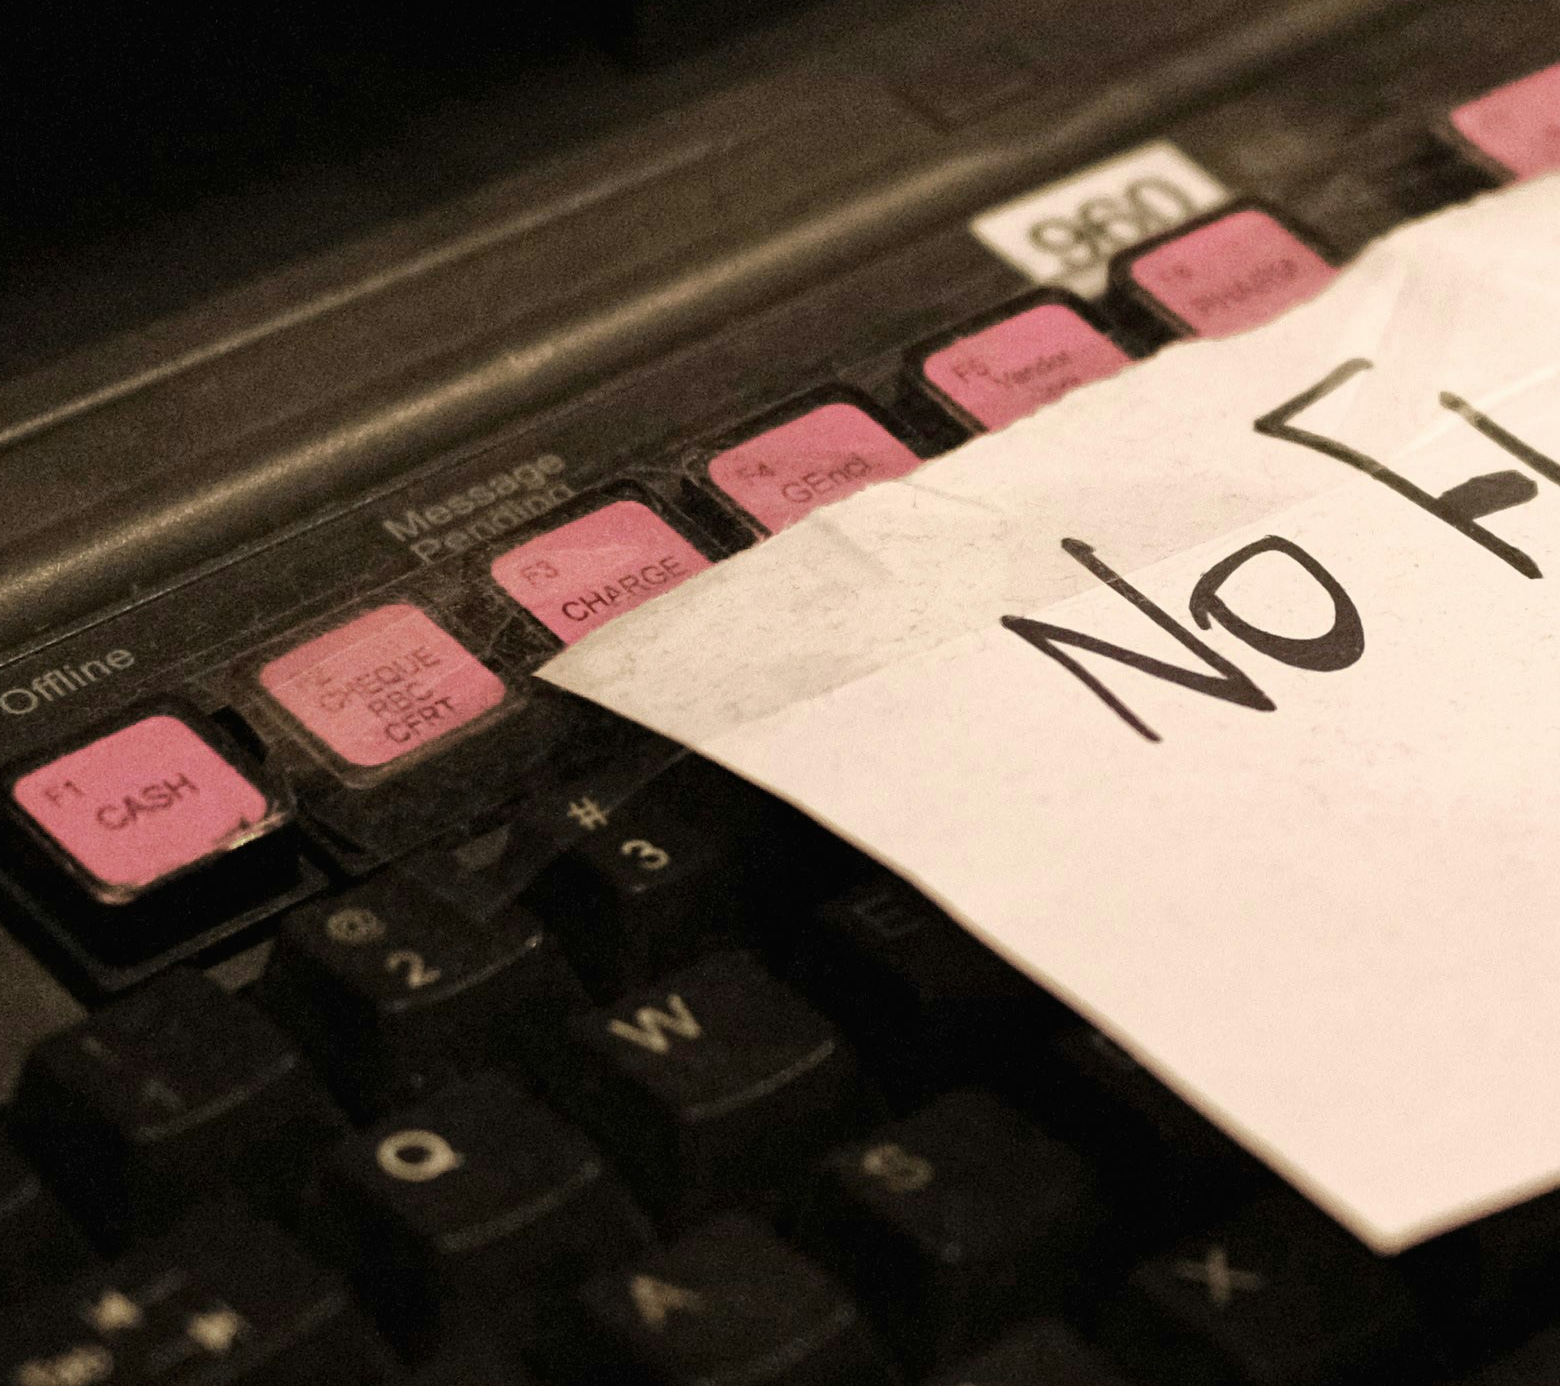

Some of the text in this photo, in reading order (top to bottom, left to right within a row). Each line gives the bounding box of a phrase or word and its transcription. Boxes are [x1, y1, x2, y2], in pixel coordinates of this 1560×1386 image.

[382, 453, 566, 543] Message
[409, 483, 577, 564] Pending
[518, 559, 560, 586] F3
[560, 554, 689, 623] CHARGE
[1000, 532, 1366, 744] No
[43, 779, 86, 810] F1
[96, 772, 201, 831] CASH
[619, 837, 672, 872] 3
[385, 949, 443, 990] 2
[606, 993, 703, 1056] W
